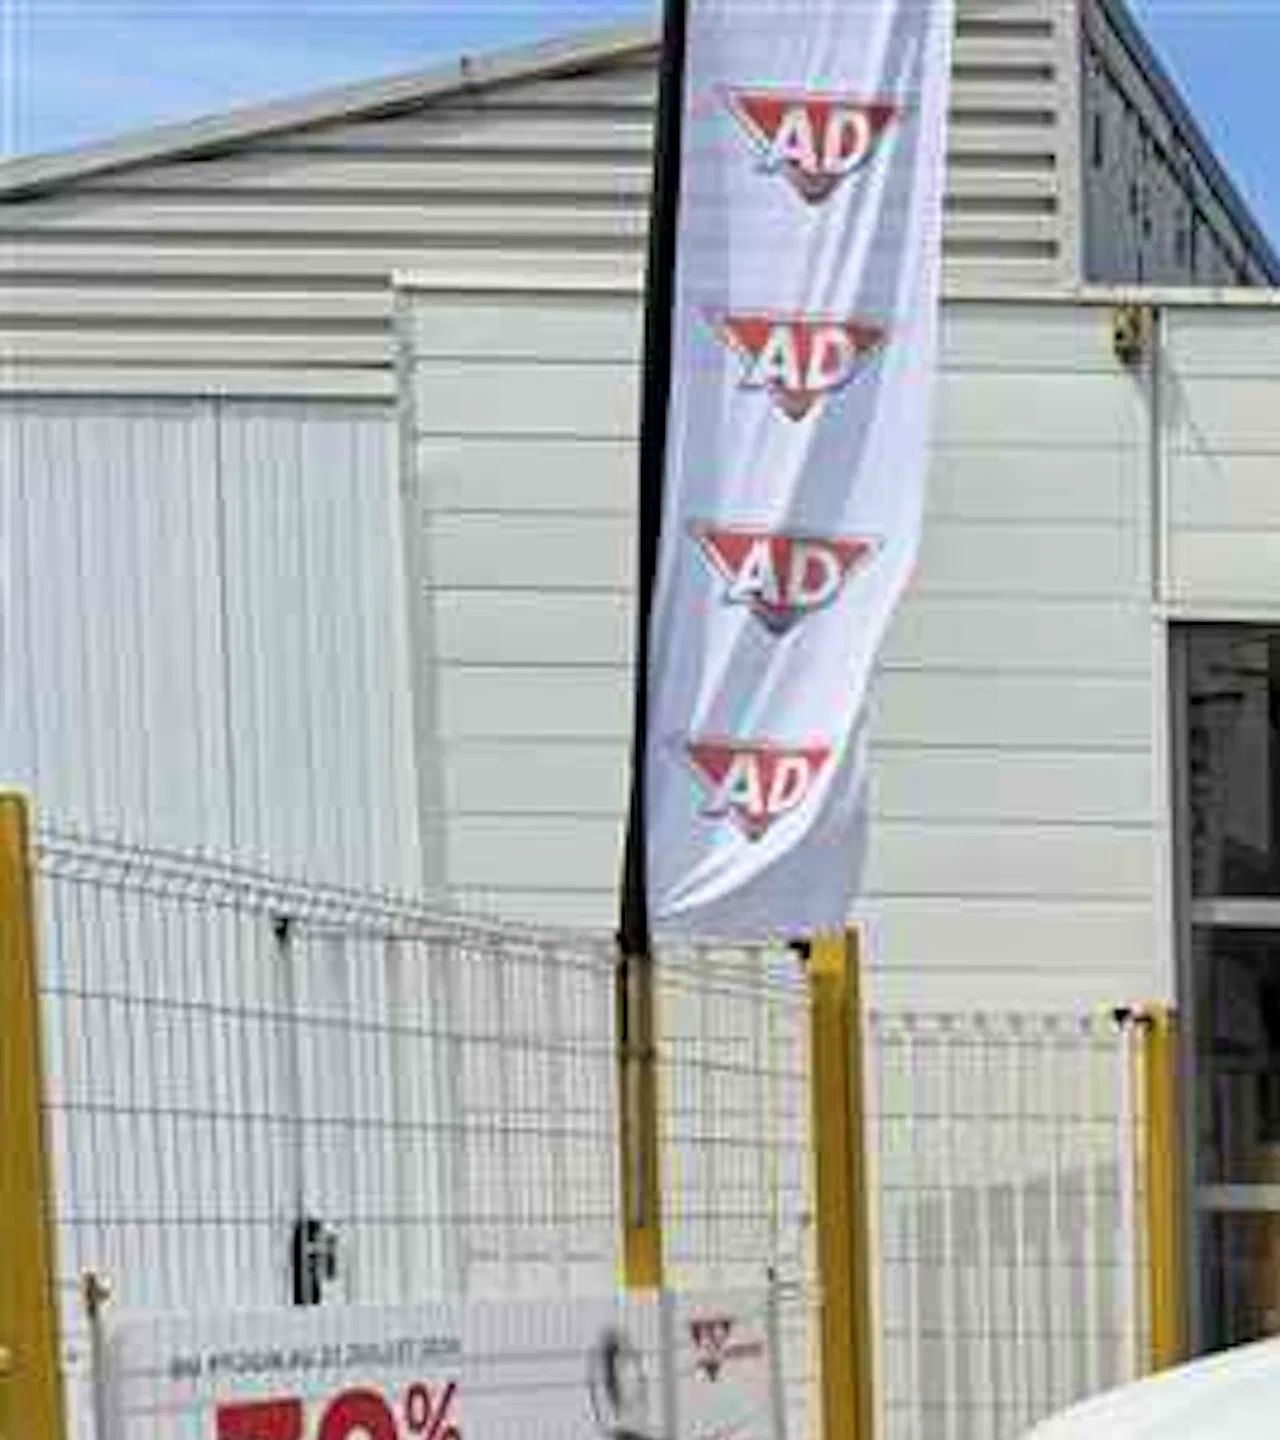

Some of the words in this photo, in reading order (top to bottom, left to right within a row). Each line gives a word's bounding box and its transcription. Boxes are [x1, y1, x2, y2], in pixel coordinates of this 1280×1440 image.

[754, 108, 872, 176] AD
[737, 324, 856, 394] AD
[719, 534, 846, 606] AD
[700, 756, 812, 824] AD
